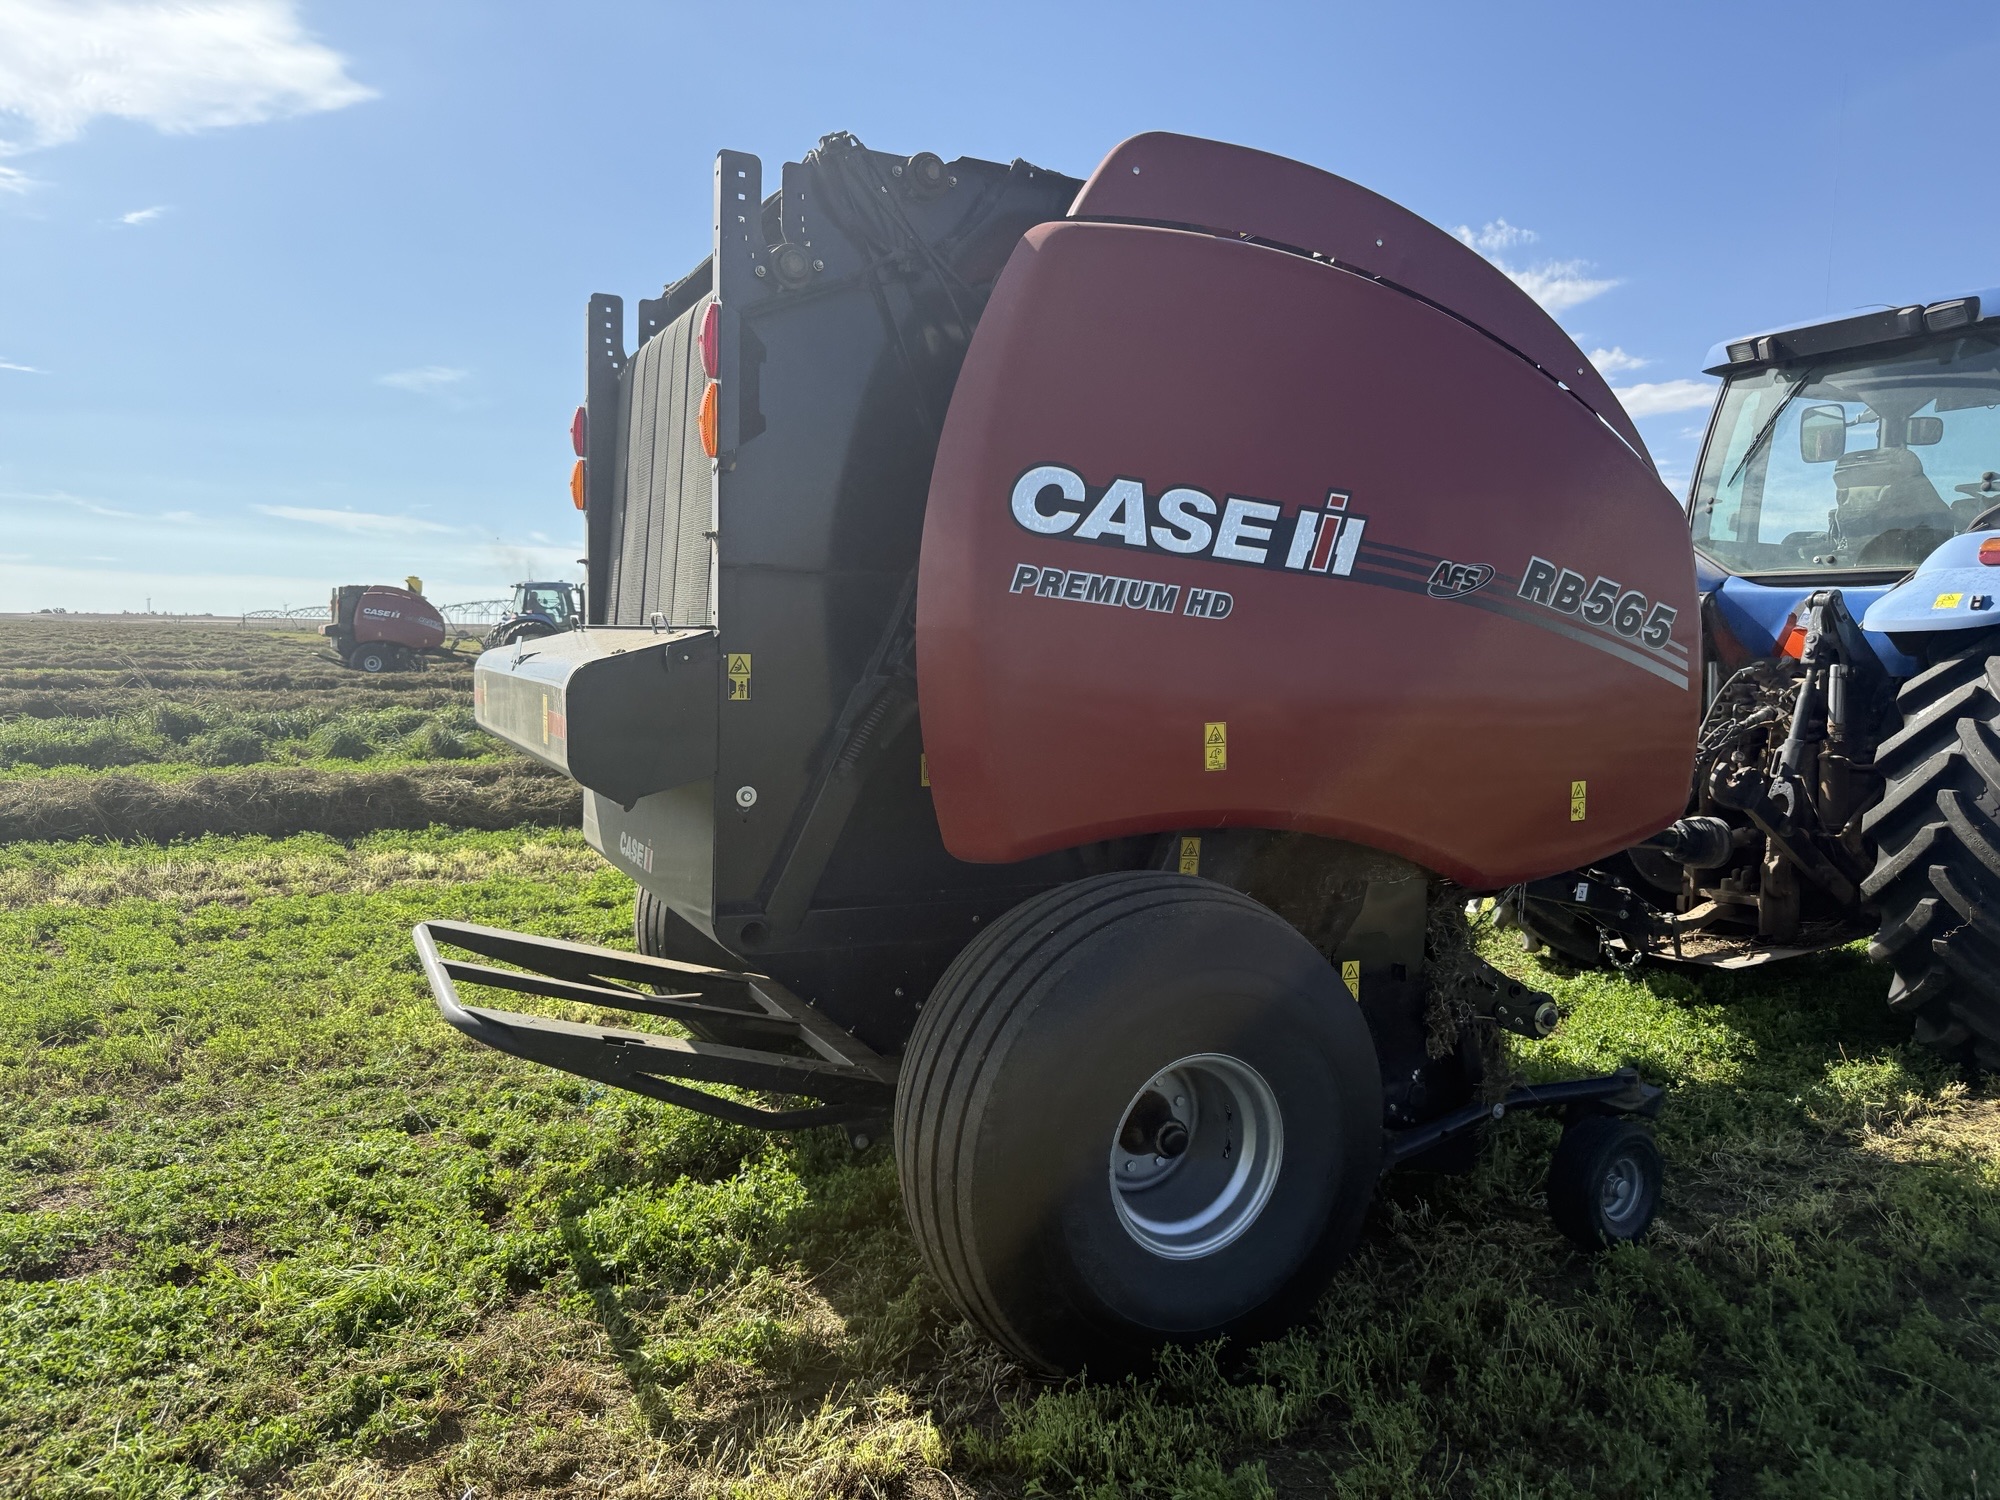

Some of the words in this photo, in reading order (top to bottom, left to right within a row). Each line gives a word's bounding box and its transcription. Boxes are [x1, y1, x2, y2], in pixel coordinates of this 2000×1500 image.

[1010, 465, 1282, 564] CASE
[1009, 563, 1181, 614] PREMIUM
[1184, 589, 1234, 620] HD
[1427, 560, 1483, 591] AFS
[363, 607, 391, 617] CASE
[1517, 555, 1678, 650] RB565
[620, 831, 644, 868] CASE
